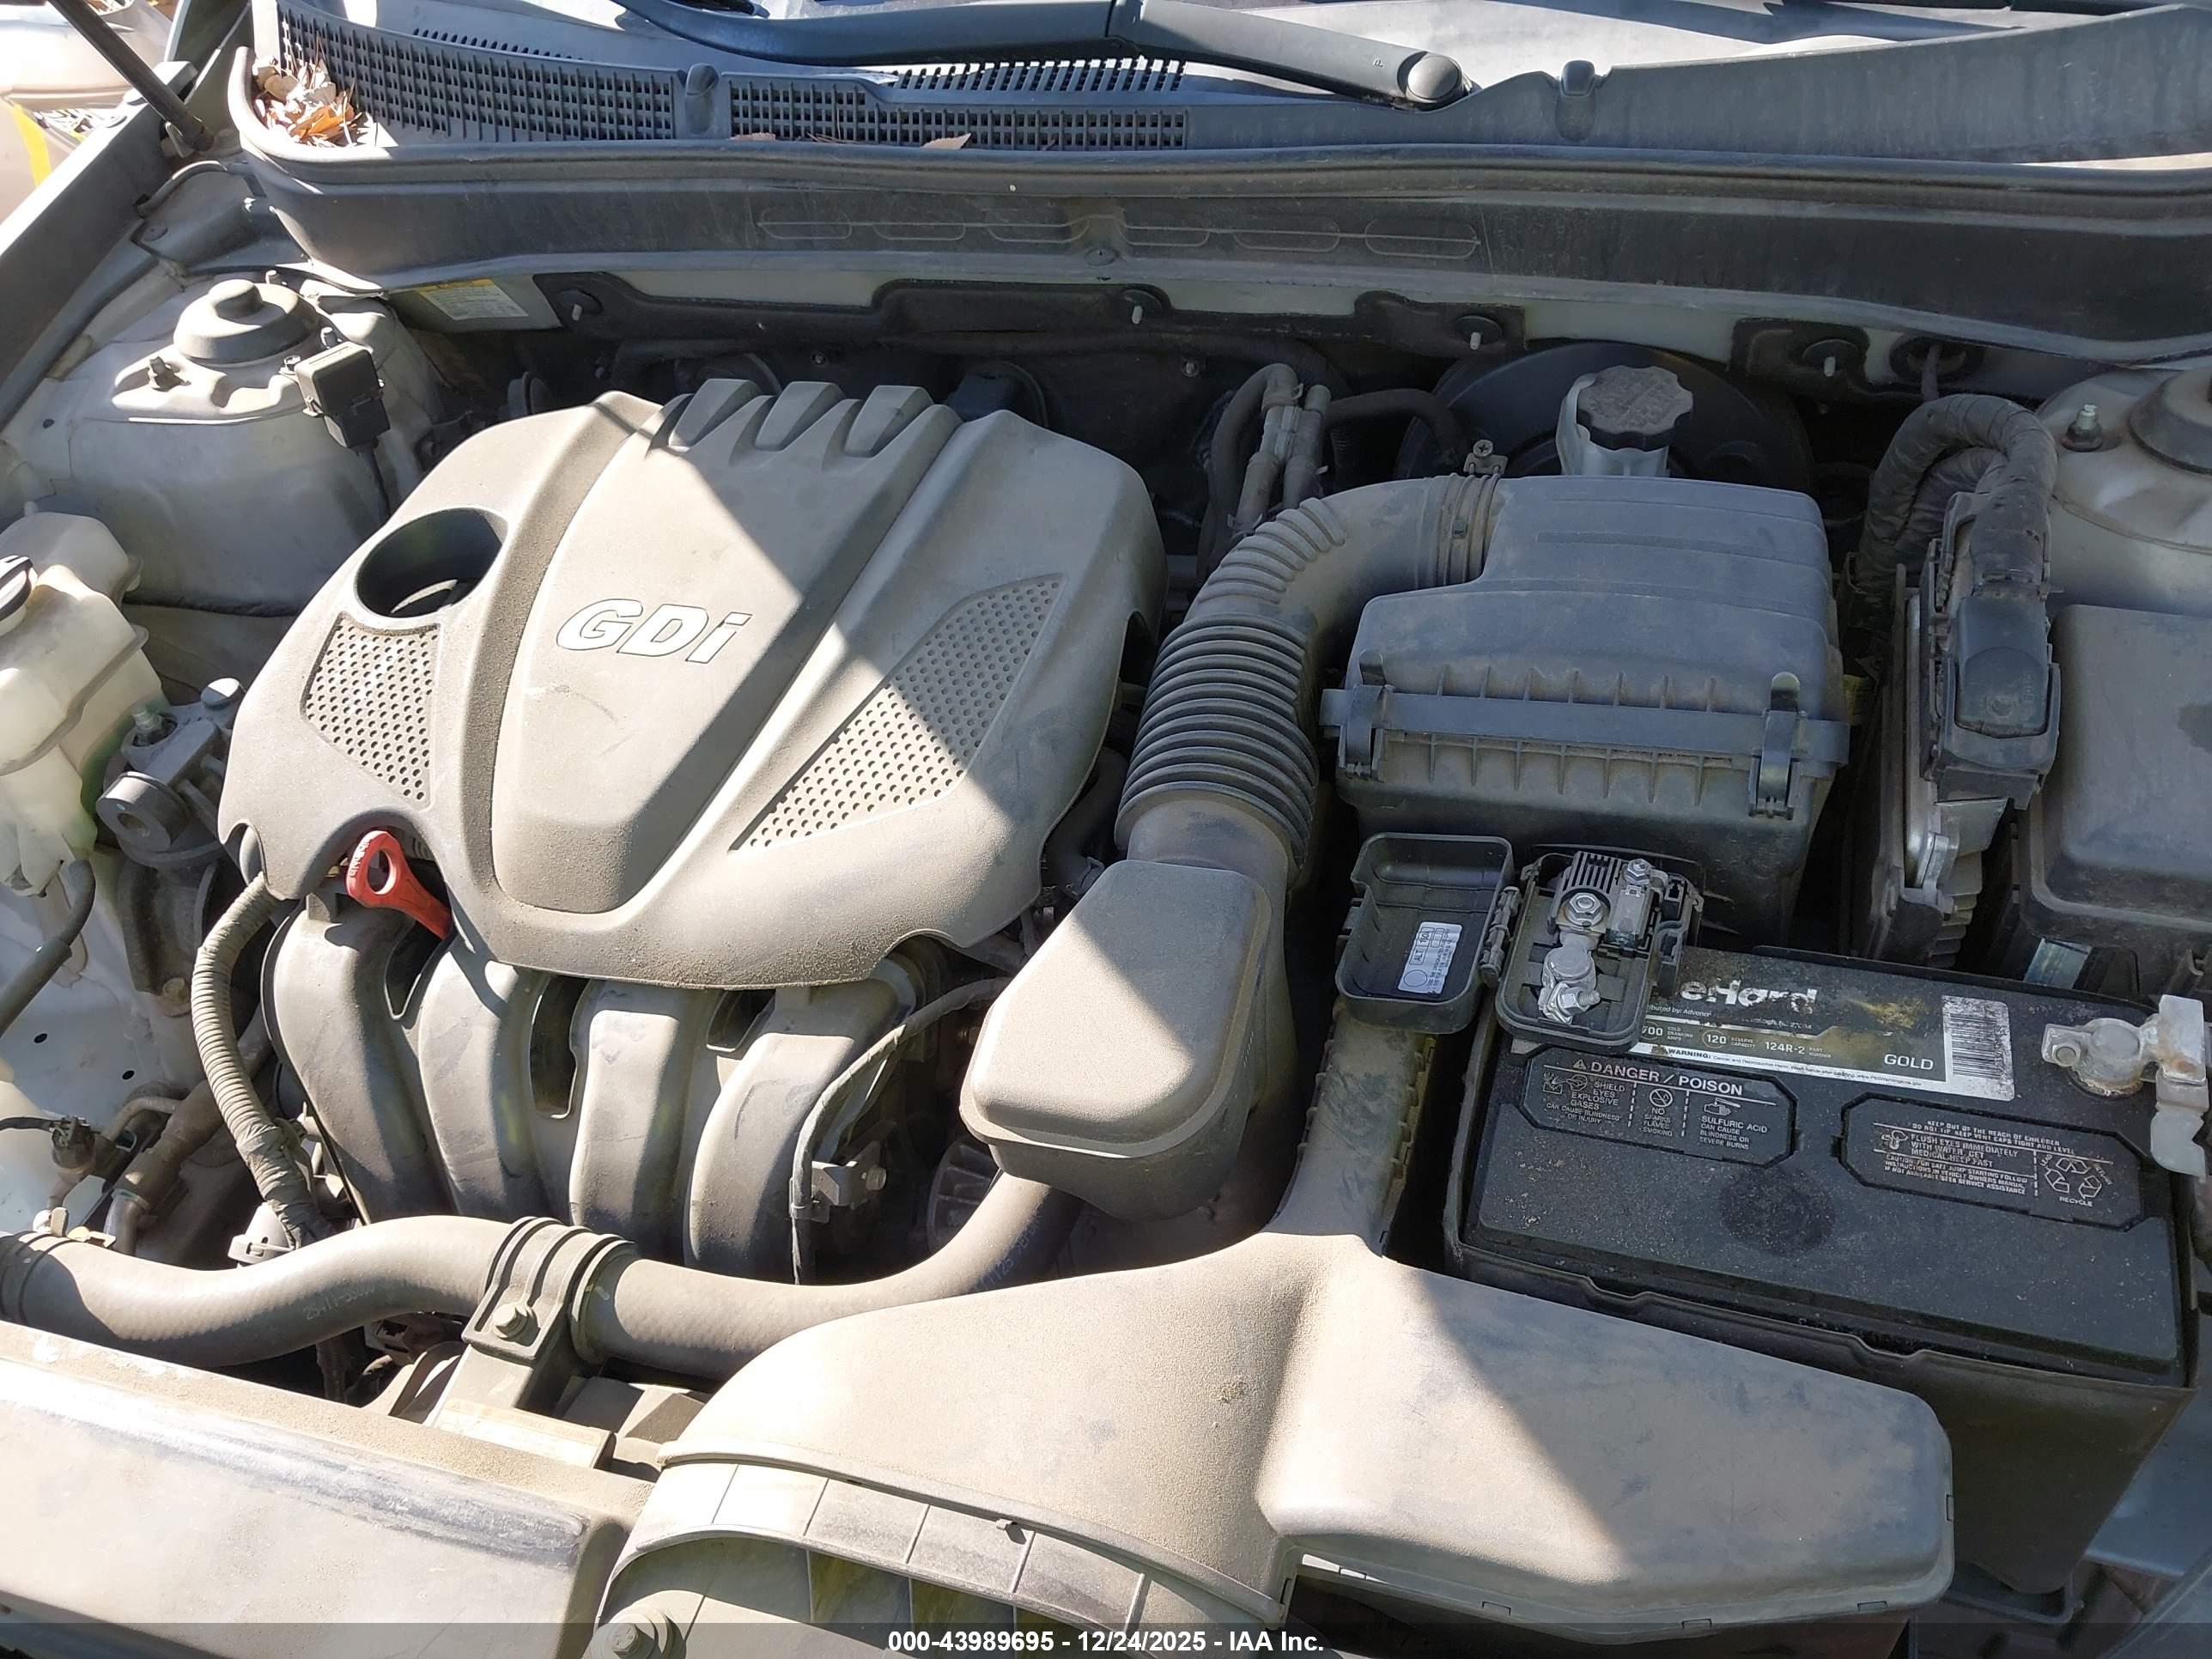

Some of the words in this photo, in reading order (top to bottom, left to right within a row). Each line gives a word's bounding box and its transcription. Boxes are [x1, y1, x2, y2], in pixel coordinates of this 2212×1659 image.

[556, 598, 753, 664] GDi
[1414, 950, 1423, 962] ALT
[1705, 1033, 1727, 1045] 120
[1668, 1048, 1711, 1060] WARNING:
[1765, 1041, 1807, 1054] 124R-2
[1884, 1053, 1934, 1070] GOLD
[1590, 1061, 1660, 1082] DANGER
[1679, 1075, 1743, 1096] POISON
[1593, 1088, 1616, 1098] EYES
[1594, 1081, 1626, 1092] SHIELD
[1571, 1091, 1619, 1106] EXPLOSIVE
[1571, 1099, 1600, 1110] GASES
[1561, 1105, 1583, 1114] CAUSE
[1584, 1109, 1620, 1121] BLINDNESS
[1701, 1116, 1744, 1129] SULFURIC
[1747, 1123, 1767, 1133] ACID
[1717, 1126, 1741, 1135] CAUSE
[1699, 1136, 1724, 1146] SEVERE
[1726, 1141, 1749, 1150] BURNS
[1700, 1130, 1737, 1142] BLINDNESS
[1988, 1129, 2011, 1139] REACH
[2024, 1135, 2060, 1146] CHILDREN
[1911, 1133, 1938, 1145] FLUSH
[1940, 1138, 1960, 1147] EYES
[1962, 1142, 2018, 1158] IMMEDIATELY
[1911, 1142, 1932, 1151] WITH
[1969, 1151, 1984, 1159] GET
[1994, 1136, 2012, 1145] CAPS
[2014, 1139, 2034, 1148] TIGHT
[2053, 1146, 2075, 1155] LEVEL
[1911, 1148, 1948, 1159] MEDICAL
[1949, 1154, 1971, 1164] HELP
[1973, 1158, 1993, 1167] FAST
[2039, 1154, 2052, 1168] LEAD
[1886, 1161, 1931, 1173] INSTRUCTIONS
[1968, 1174, 1997, 1185] OWNERS
[1967, 1168, 1998, 1179] STARTING
[2000, 1173, 2027, 1182] FOLLOW
[1959, 1177, 1984, 1188] SERVICE
[1986, 1182, 2027, 1195] ASSISTANCE
[2059, 1196, 2093, 1206] RECYCLE
